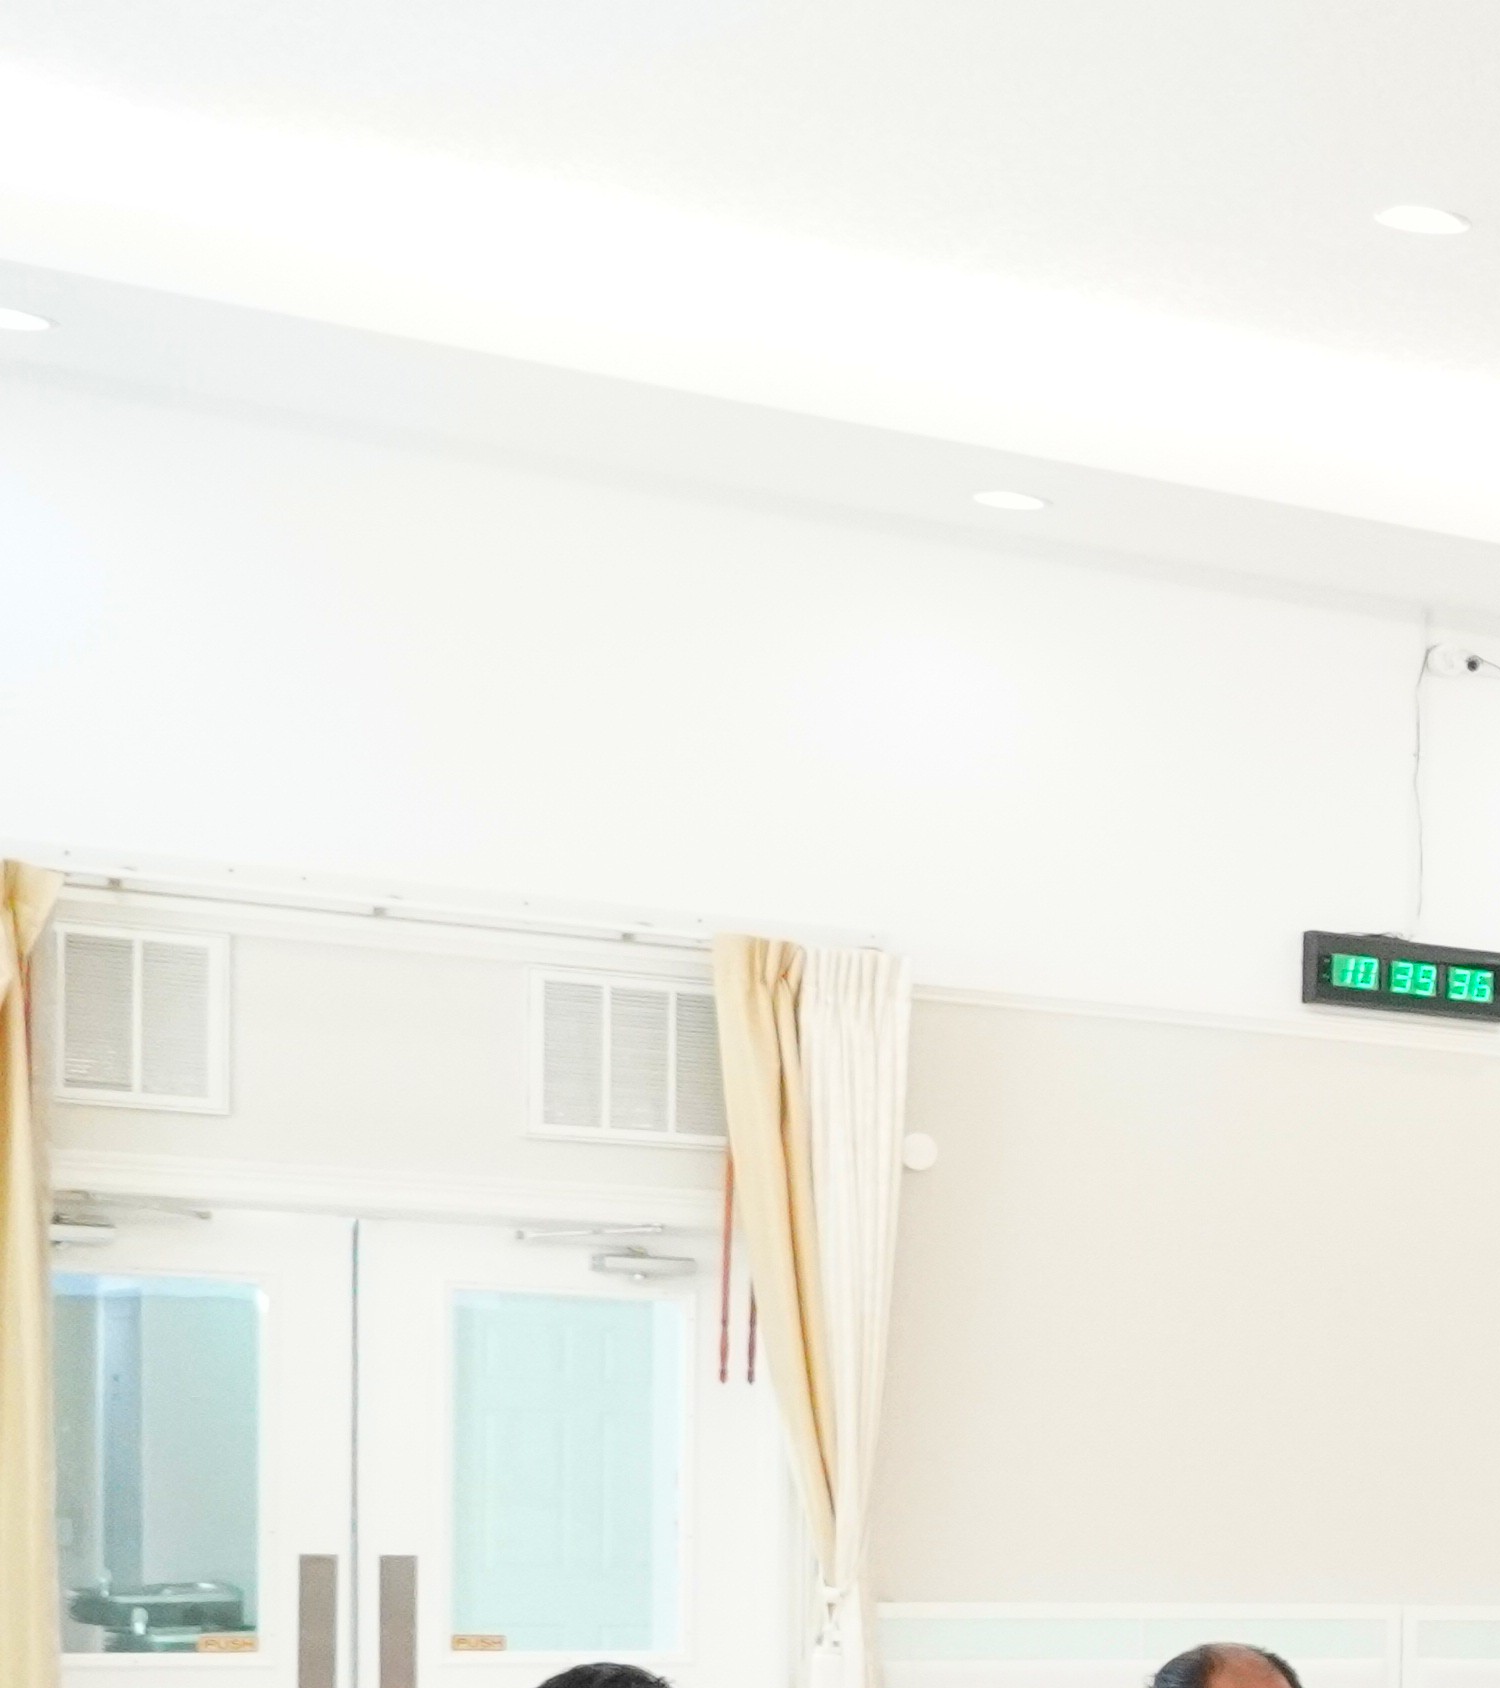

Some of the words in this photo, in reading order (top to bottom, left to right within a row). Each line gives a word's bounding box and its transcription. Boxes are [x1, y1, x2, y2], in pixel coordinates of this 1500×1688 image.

[1339, 956, 1378, 989] 10
[1393, 961, 1437, 996] 39
[1449, 968, 1493, 1003] 36
[204, 1638, 255, 1650] PUSH
